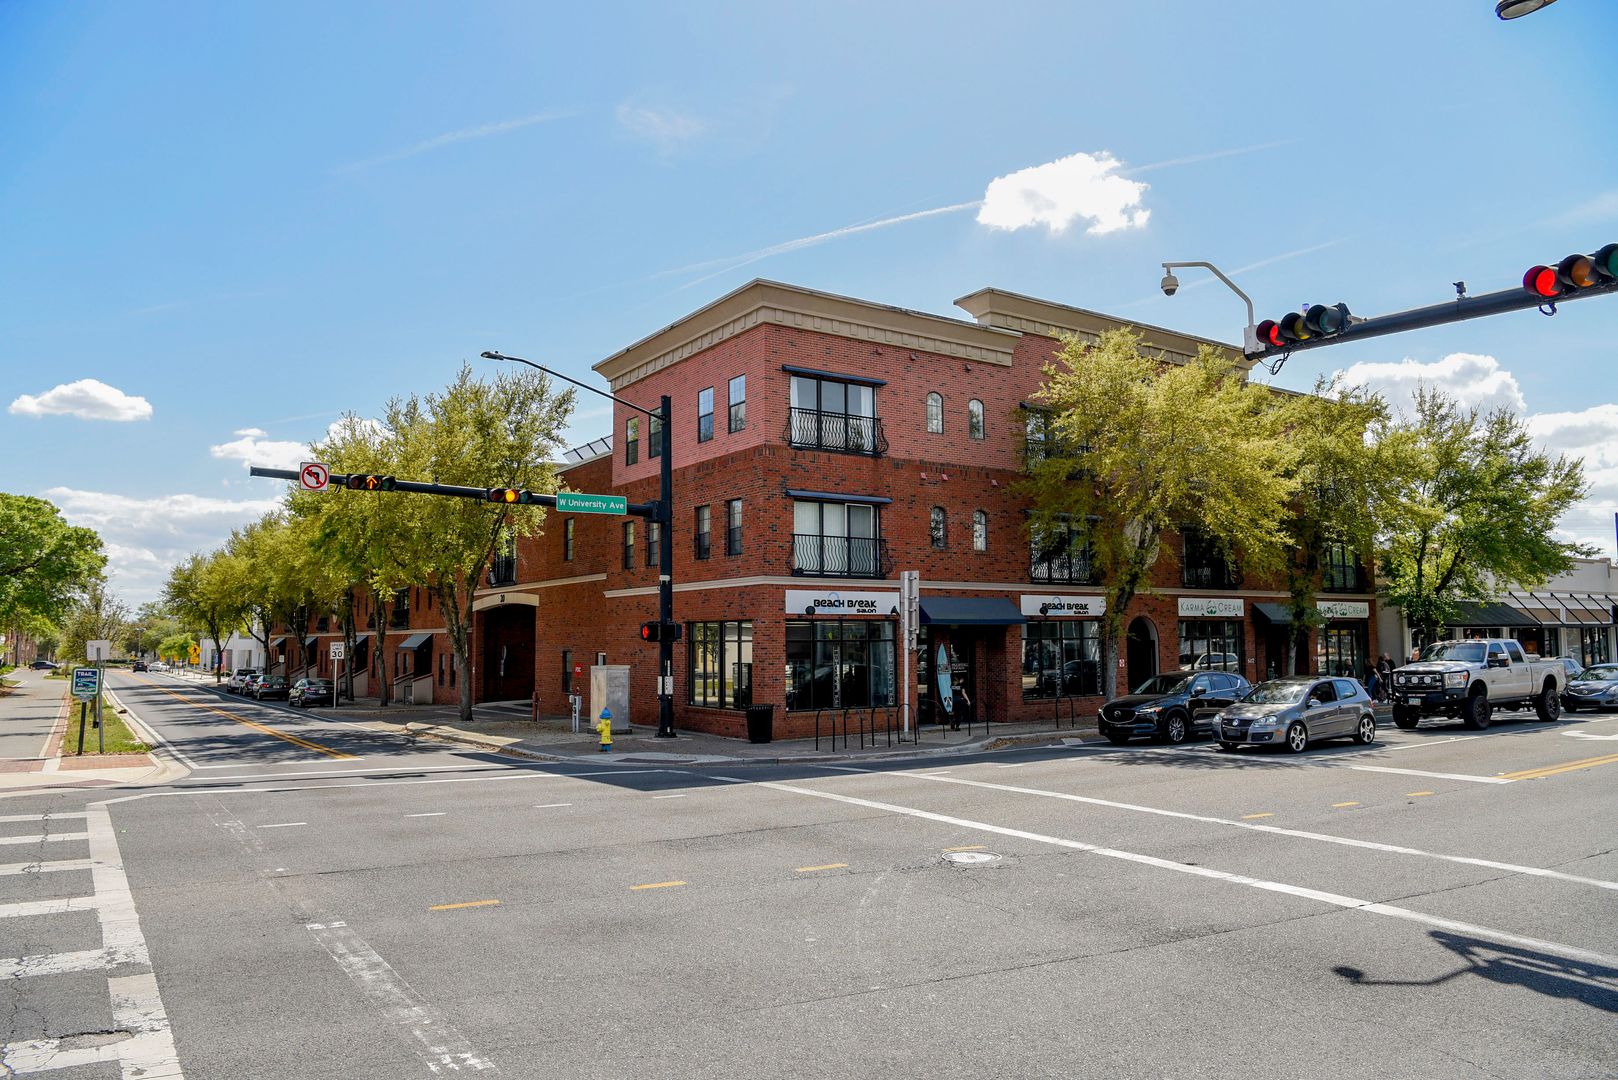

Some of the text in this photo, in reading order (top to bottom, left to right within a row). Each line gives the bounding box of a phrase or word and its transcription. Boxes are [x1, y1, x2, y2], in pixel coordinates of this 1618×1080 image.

[568, 499, 607, 510] University
[609, 501, 624, 509] Ave
[1218, 602, 1242, 612] CREAM
[331, 650, 343, 658] 30
